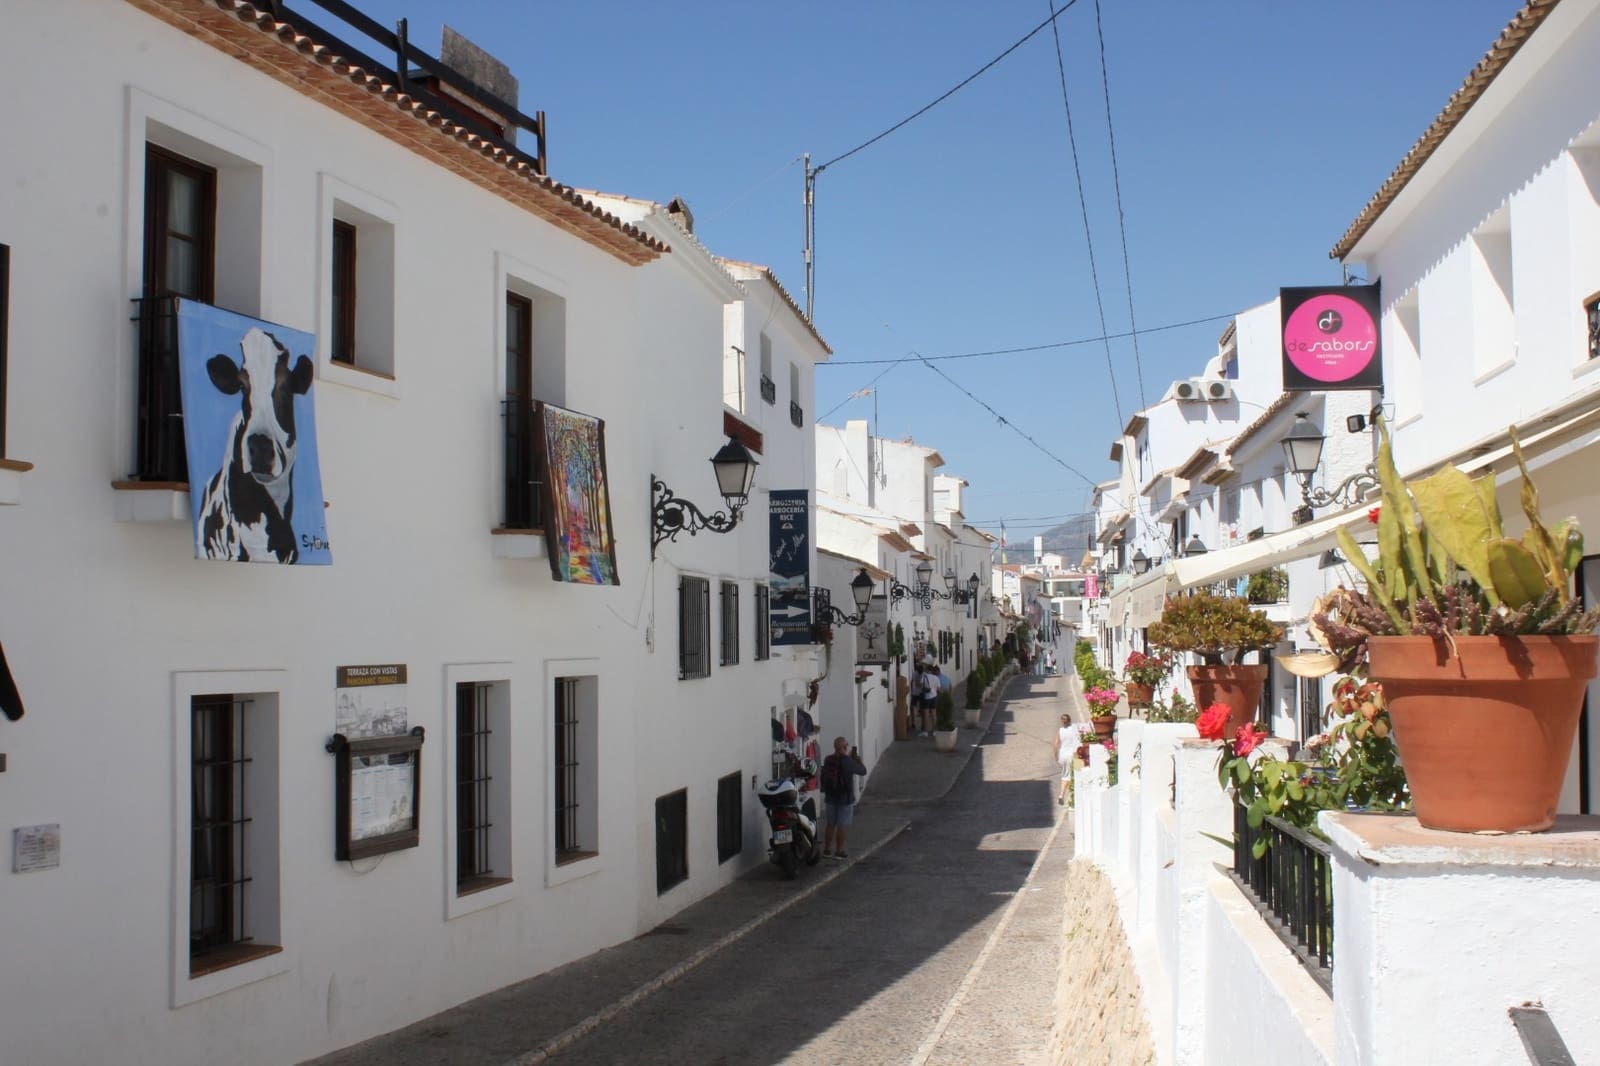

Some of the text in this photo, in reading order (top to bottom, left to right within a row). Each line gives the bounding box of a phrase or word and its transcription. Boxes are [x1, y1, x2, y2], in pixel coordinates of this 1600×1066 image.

[347, 666, 398, 677] TERRAZA CON VISTAS
